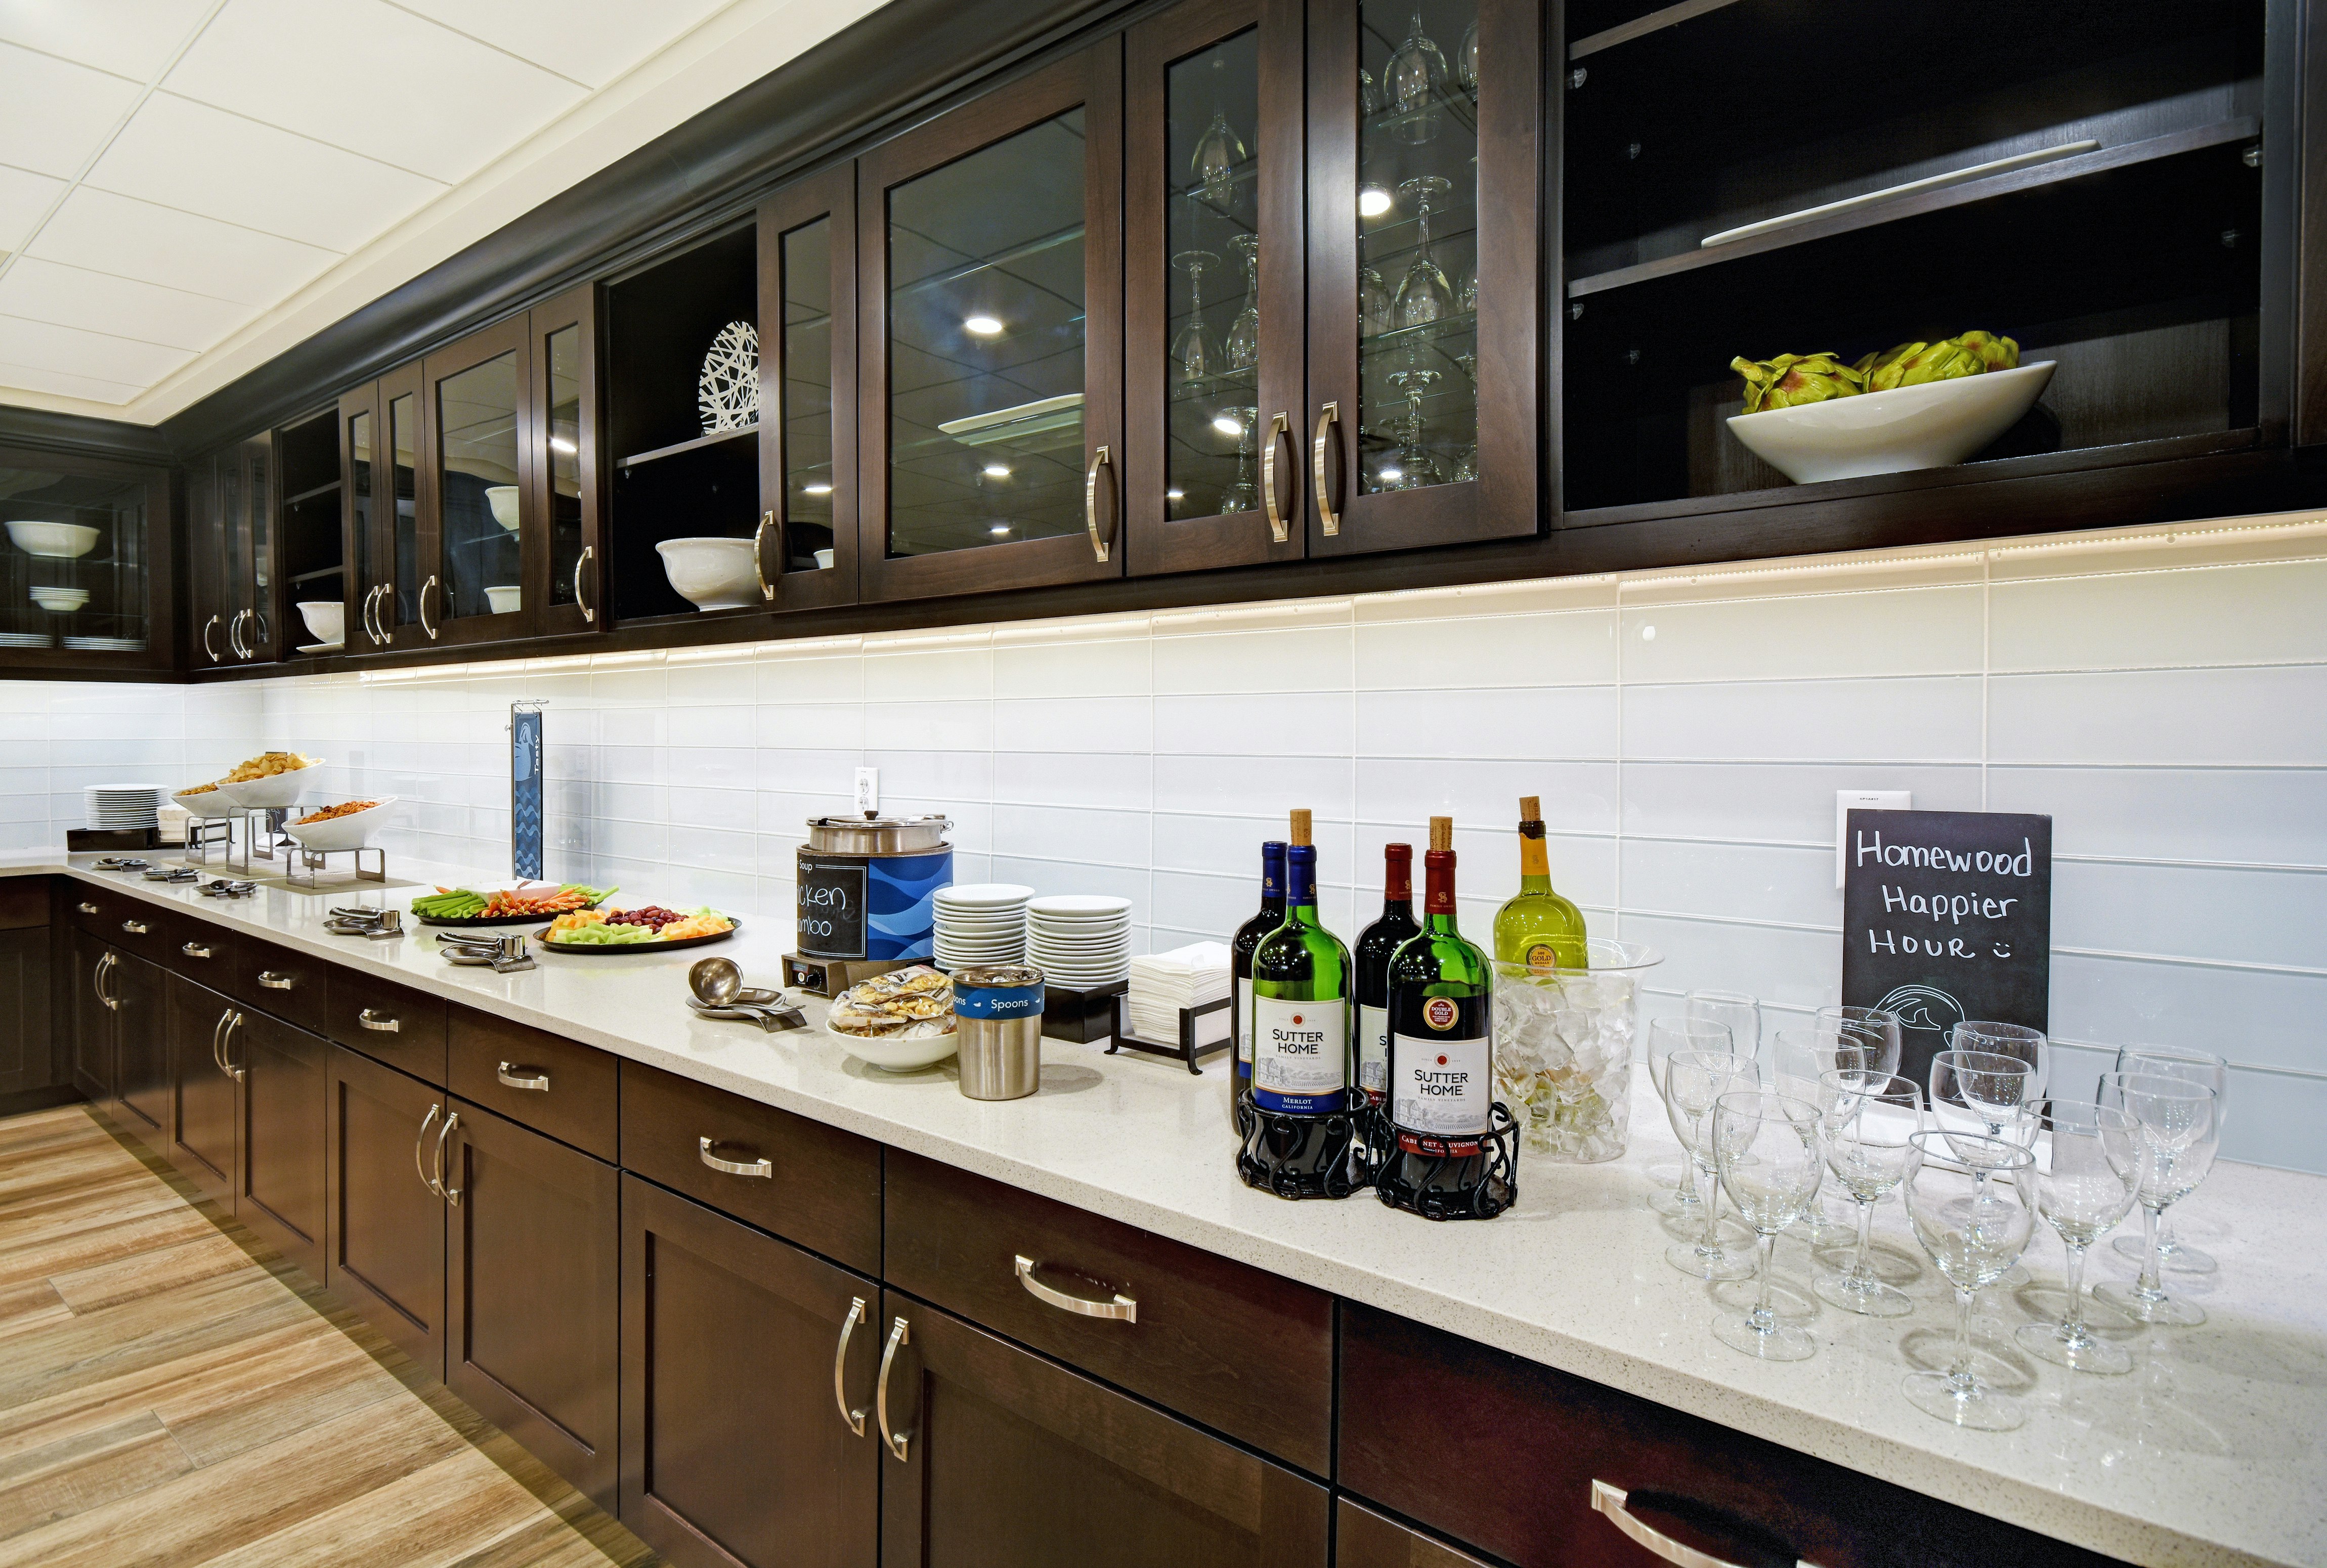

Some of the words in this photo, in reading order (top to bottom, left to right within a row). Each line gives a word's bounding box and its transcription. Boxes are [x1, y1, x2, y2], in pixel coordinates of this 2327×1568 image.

[1857, 830, 2032, 877] Homewood
[799, 859, 813, 874] Soup
[798, 884, 846, 910] icken
[1882, 885, 2018, 925] Happier
[798, 916, 832, 936] umbo
[954, 995, 966, 1006] oons
[991, 999, 1028, 1012] Spoons
[1272, 1029, 1323, 1042] SUTTER
[1278, 1042, 1318, 1054] HOME
[1414, 1069, 1469, 1083] SUTTER
[1420, 1084, 1463, 1096] HOME
[1401, 1135, 1437, 1147] CABENET
